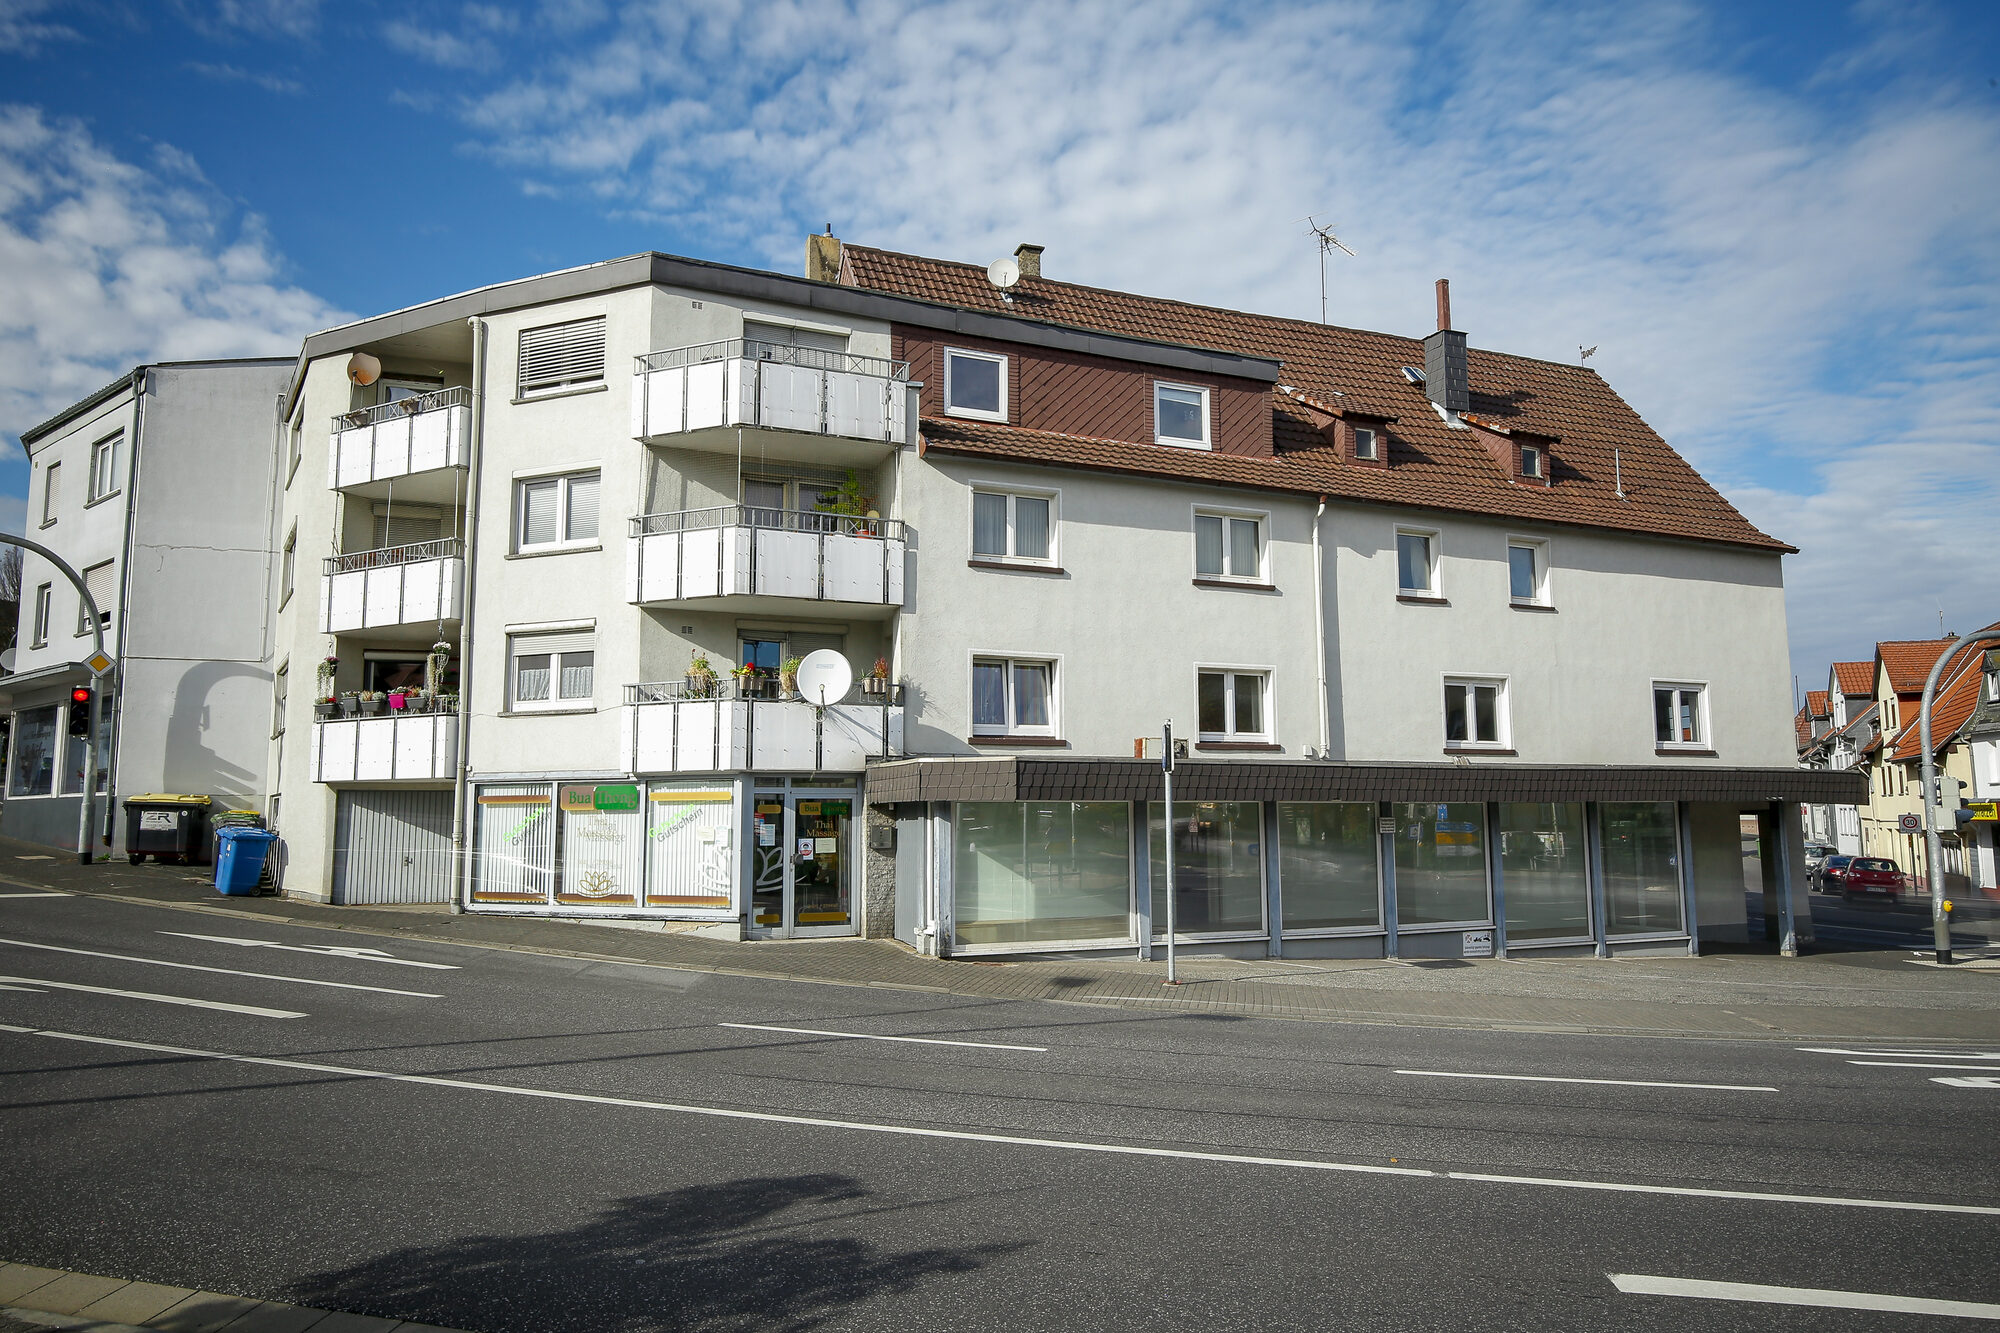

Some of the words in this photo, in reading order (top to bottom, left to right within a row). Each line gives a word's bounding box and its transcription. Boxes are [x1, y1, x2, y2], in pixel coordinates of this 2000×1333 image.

[568, 791, 592, 804] Bua
[597, 790, 636, 808] Thong
[804, 804, 819, 812] Bua
[648, 803, 695, 838] Gutschein
[815, 820, 833, 829] Thai
